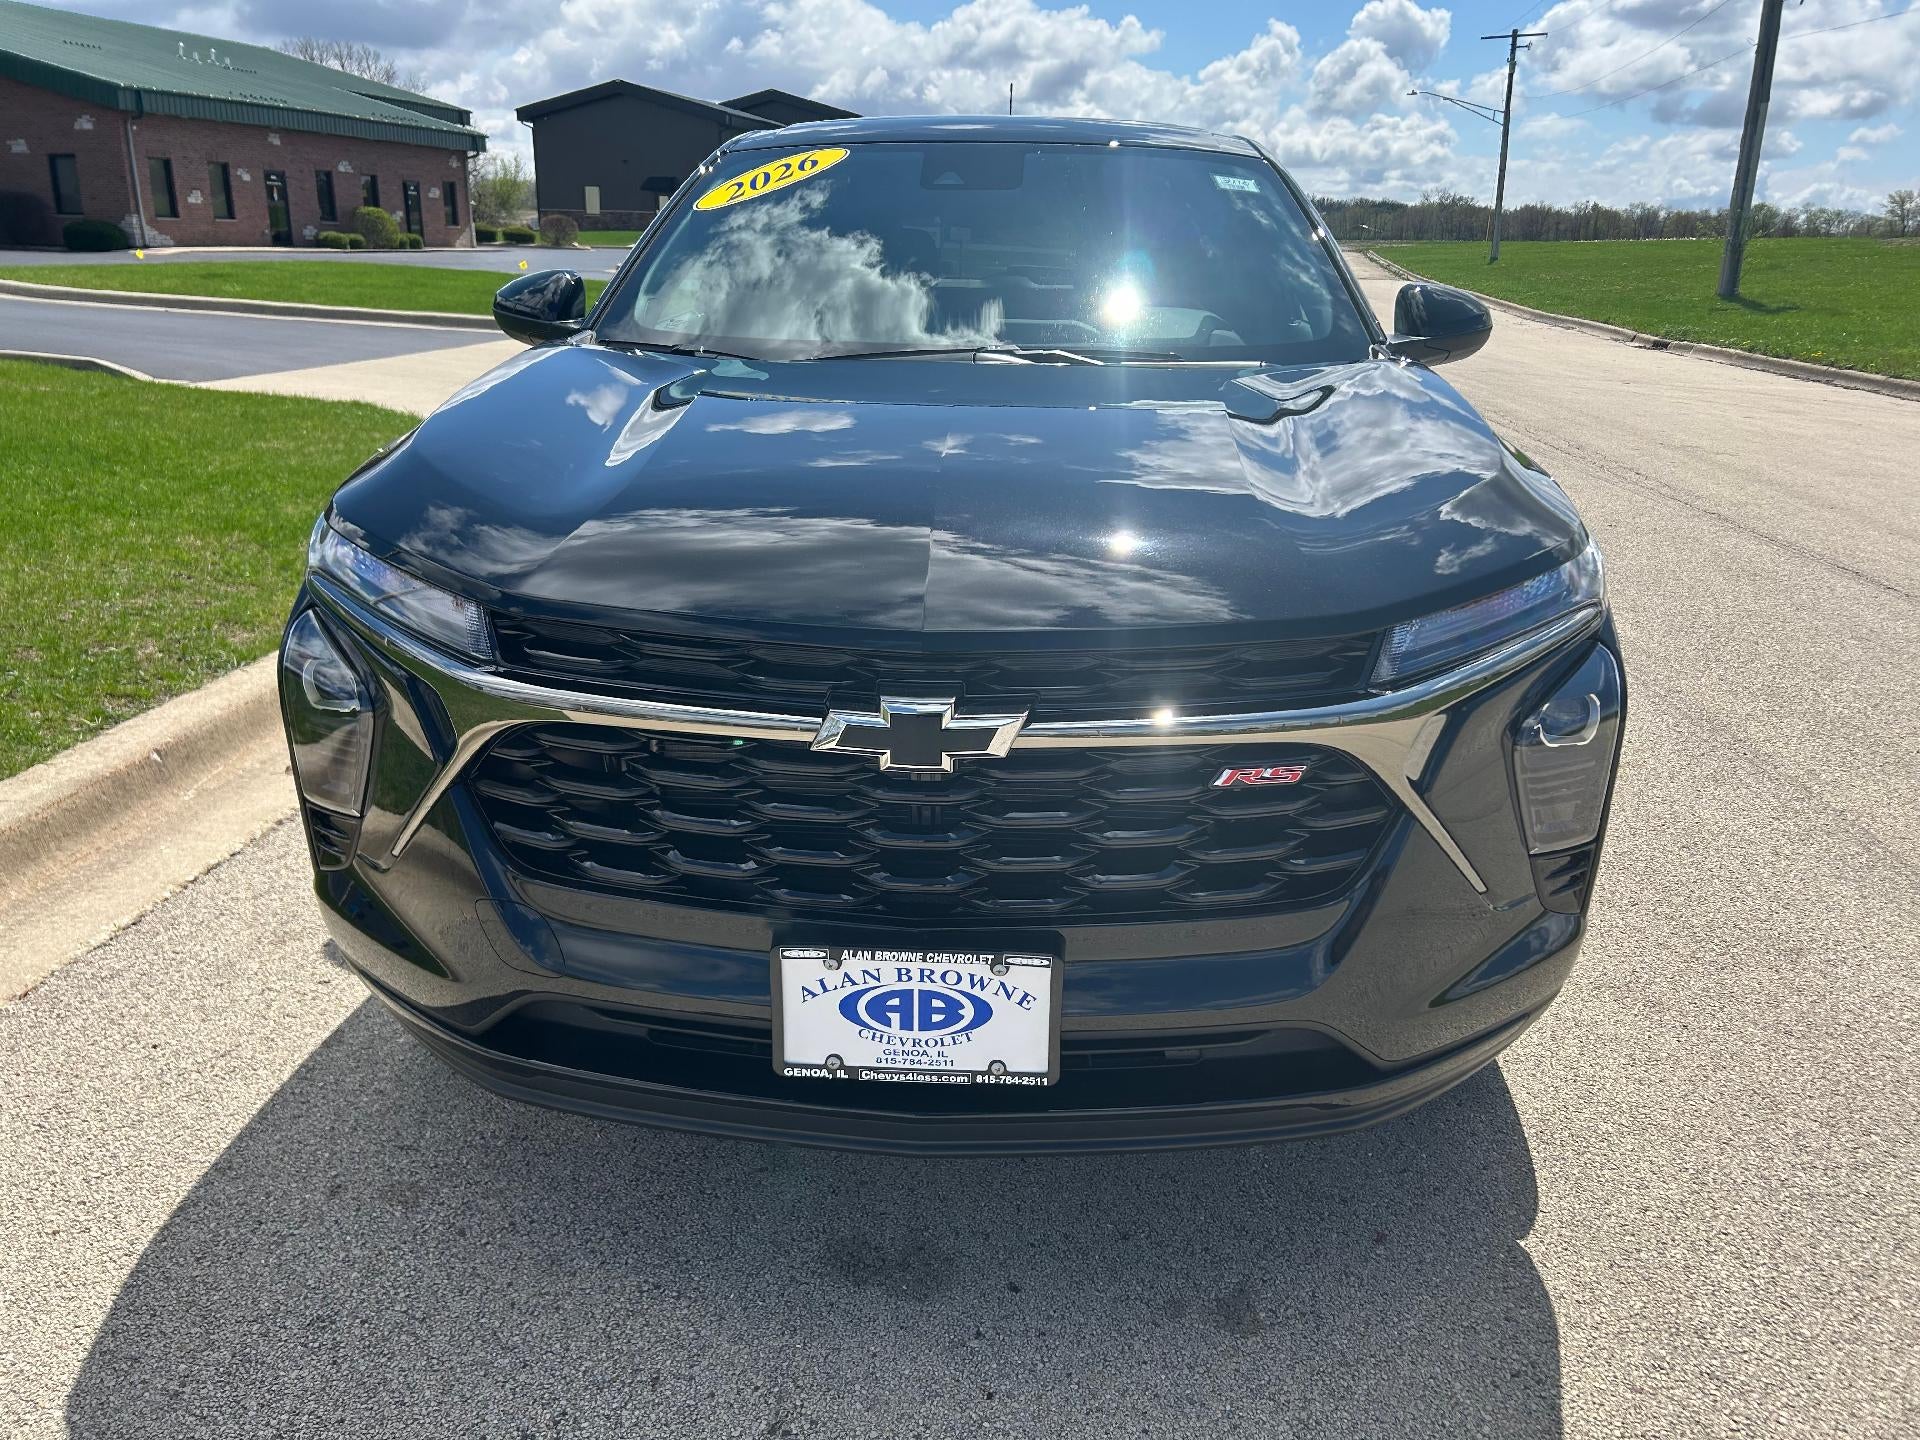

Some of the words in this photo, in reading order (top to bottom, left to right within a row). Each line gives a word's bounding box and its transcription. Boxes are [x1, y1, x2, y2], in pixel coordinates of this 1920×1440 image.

[725, 153, 819, 203] 2026
[1213, 766, 1307, 786] RS
[841, 950, 871, 961] ALAN
[874, 951, 923, 962] BROWNE
[926, 952, 995, 965] CHEVROLET
[800, 967, 882, 1003] ALAN
[895, 967, 1038, 1011] BROWNE
[858, 1028, 975, 1048] CHEVROLET
[883, 1048, 933, 1058] GENOA,
[937, 1050, 949, 1058] IL
[875, 1057, 955, 1067] 815-784-2511
[783, 1067, 833, 1079] GENOA,
[836, 1069, 849, 1079] IL
[861, 1070, 969, 1083] Chevys4less.com
[976, 1074, 1049, 1086] 815-784-2511
